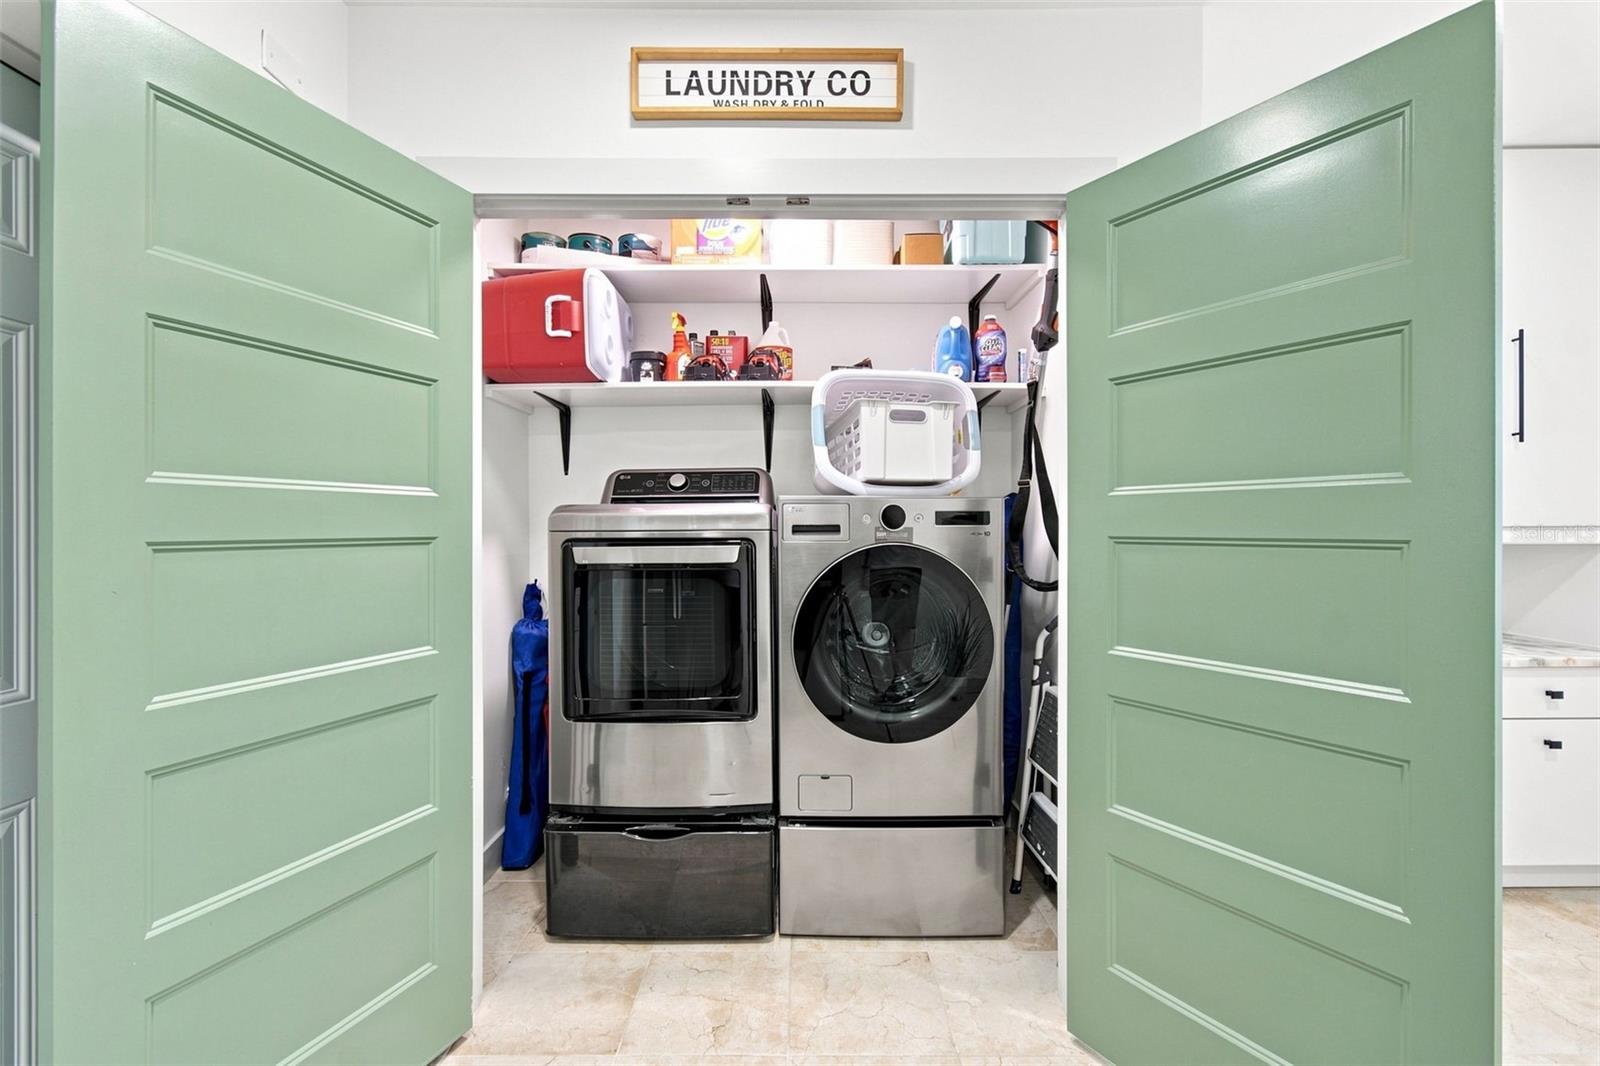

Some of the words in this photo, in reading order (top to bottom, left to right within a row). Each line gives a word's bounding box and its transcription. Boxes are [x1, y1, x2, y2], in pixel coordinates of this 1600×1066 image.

[665, 70, 815, 96] LAUNDRY
[827, 70, 871, 96] CO
[713, 99, 748, 107] WASH
[753, 99, 777, 107] DRY
[793, 99, 824, 107] FOLD
